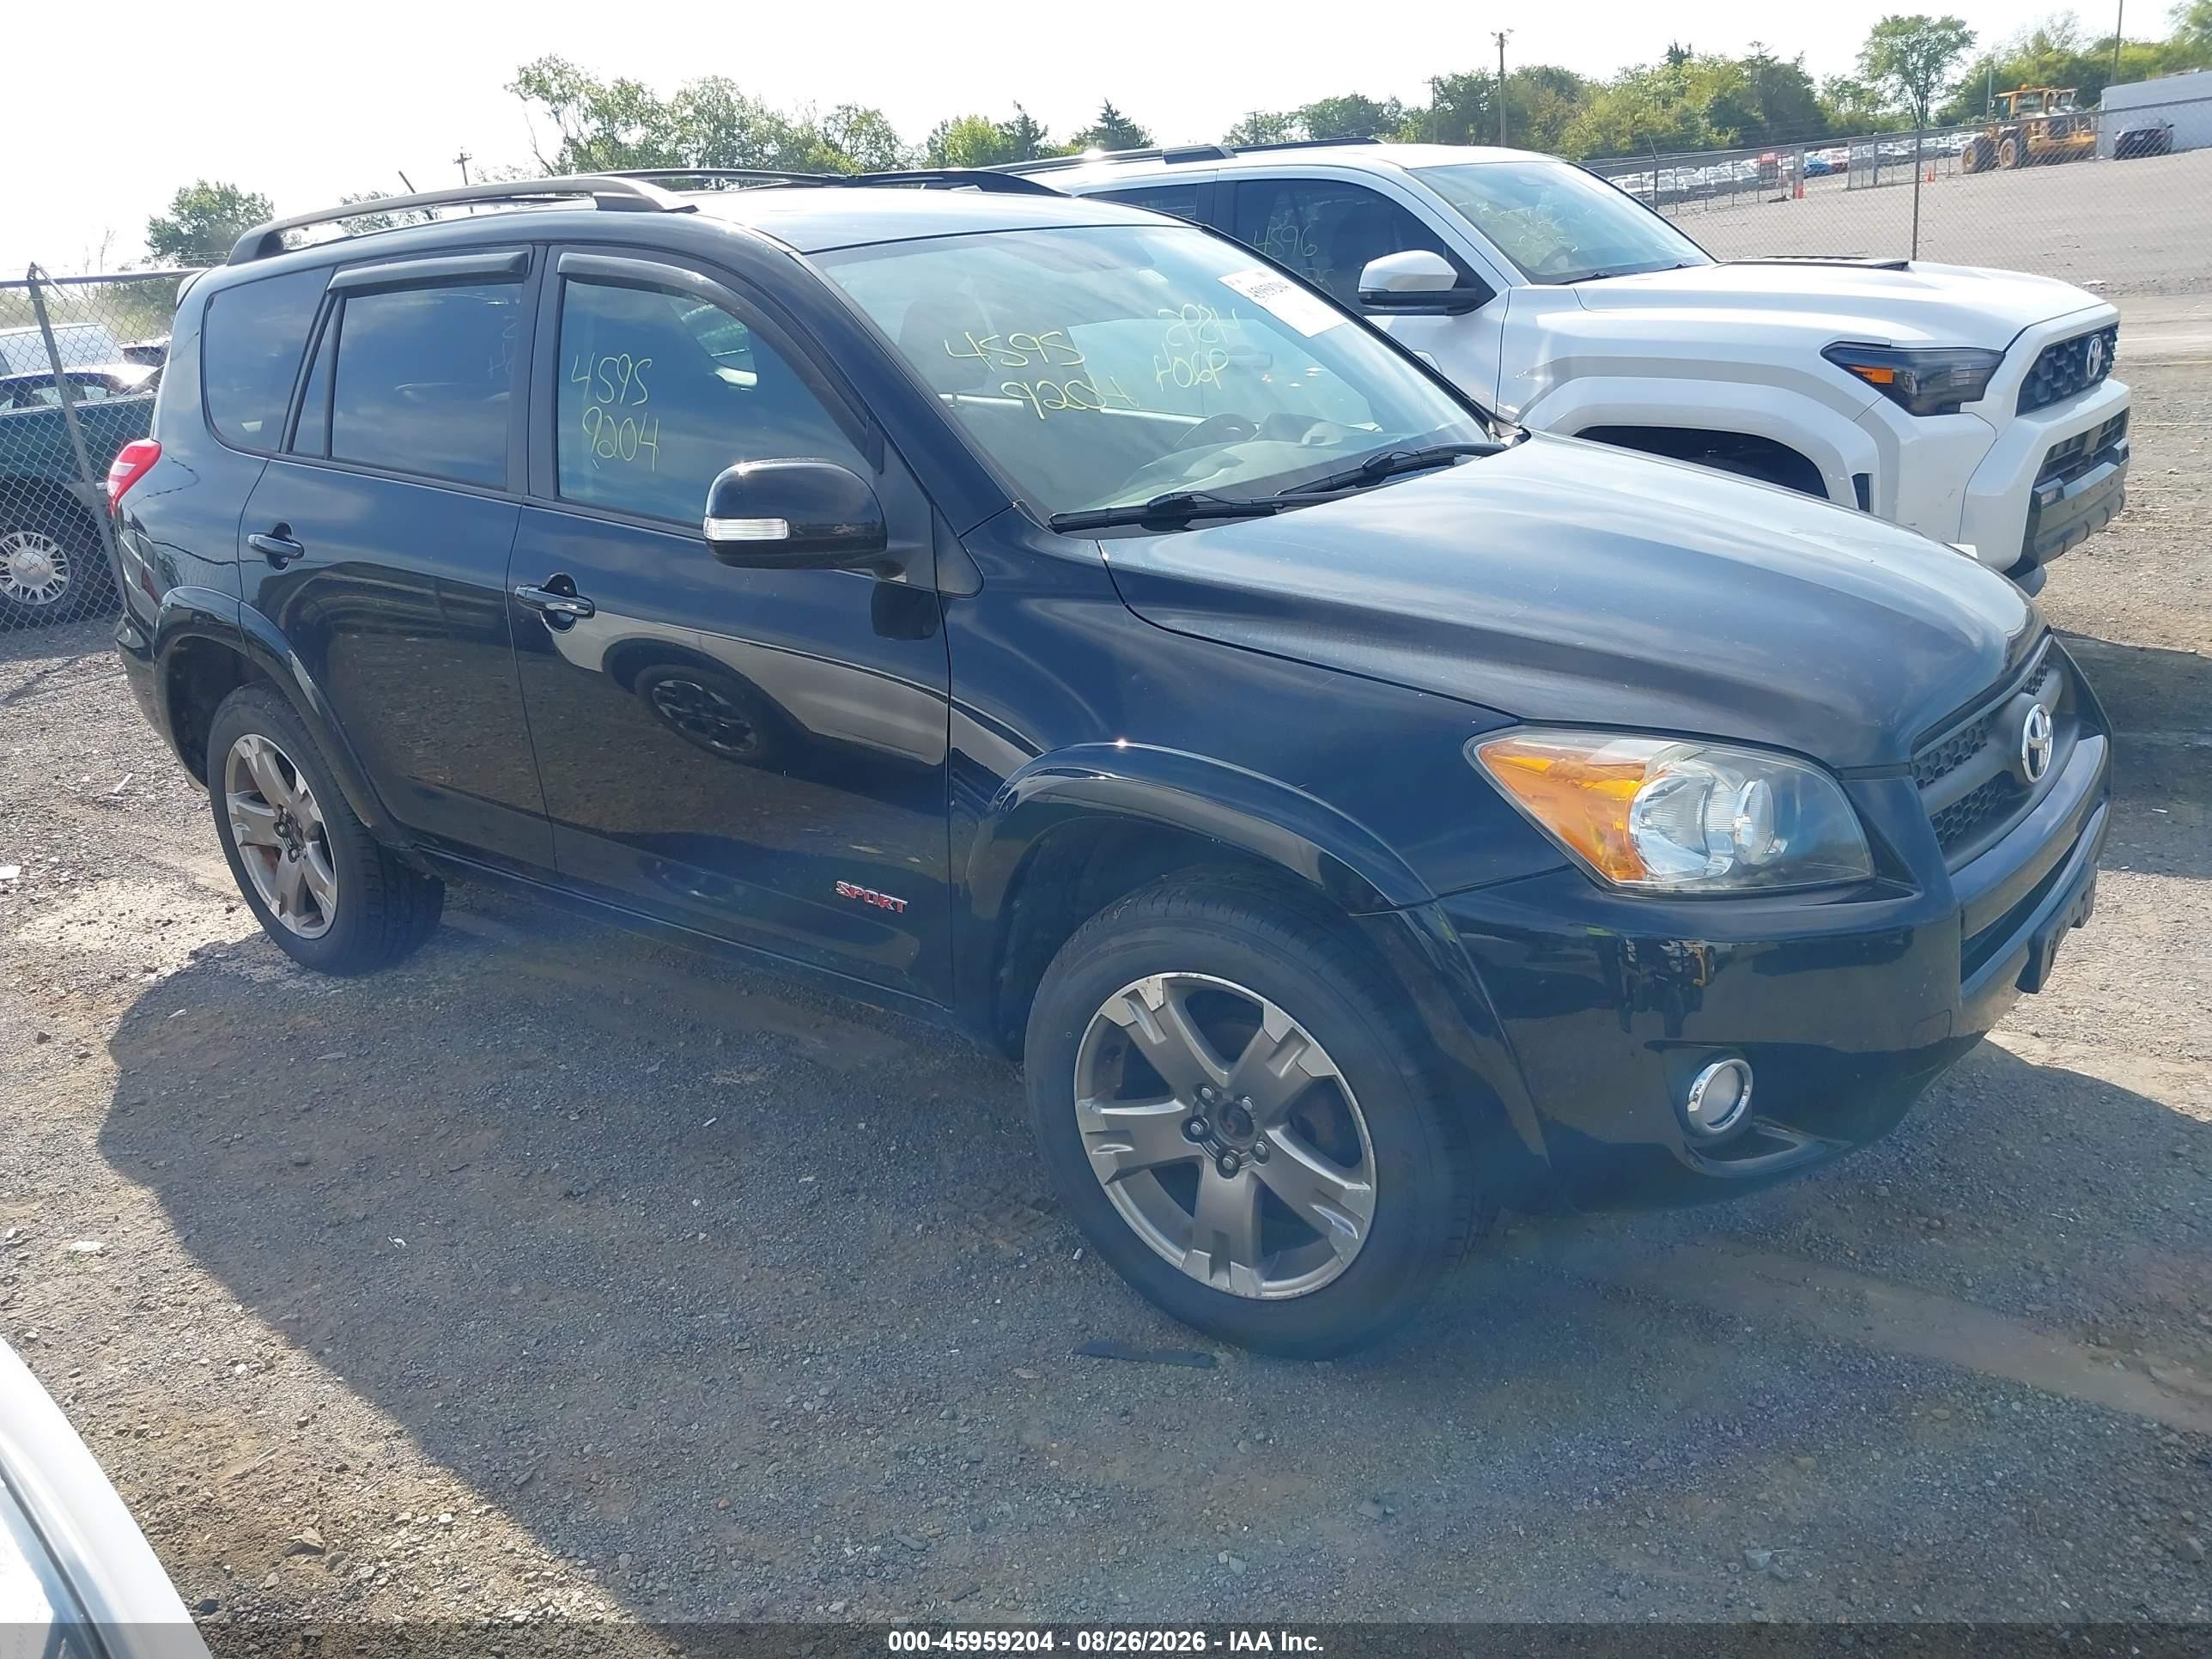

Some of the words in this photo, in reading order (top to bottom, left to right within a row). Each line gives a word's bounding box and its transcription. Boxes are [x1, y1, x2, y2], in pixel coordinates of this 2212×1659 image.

[944, 331, 1086, 373] 4595
[571, 352, 653, 406] 4595
[1000, 375, 1140, 420] 9204
[582, 406, 659, 472] 9204
[835, 879, 909, 914] SPORT
